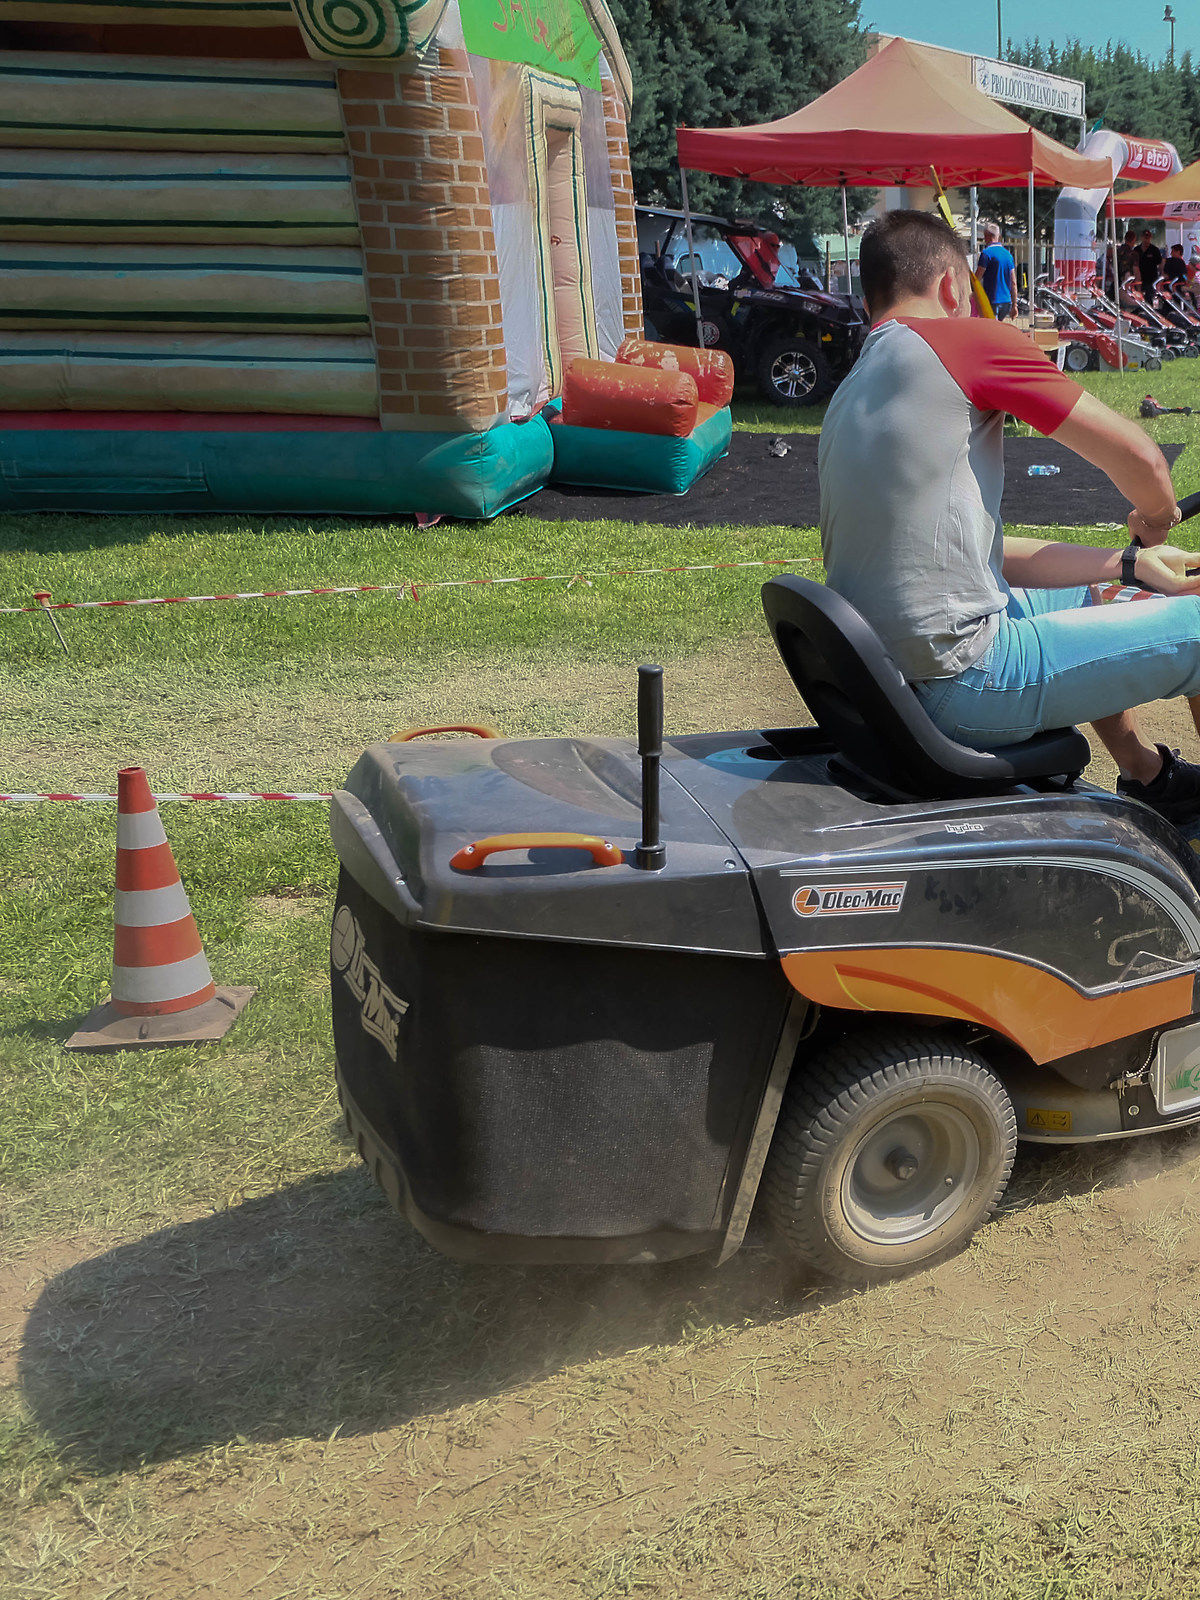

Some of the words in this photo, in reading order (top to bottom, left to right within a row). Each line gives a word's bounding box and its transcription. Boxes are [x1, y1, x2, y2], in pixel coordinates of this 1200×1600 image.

[991, 74, 1004, 95] PRO
[1004, 76, 1021, 99] LOCO
[1146, 148, 1169, 168] efco
[945, 823, 984, 834] hydro
[821, 889, 902, 910] Oleo-Mac
